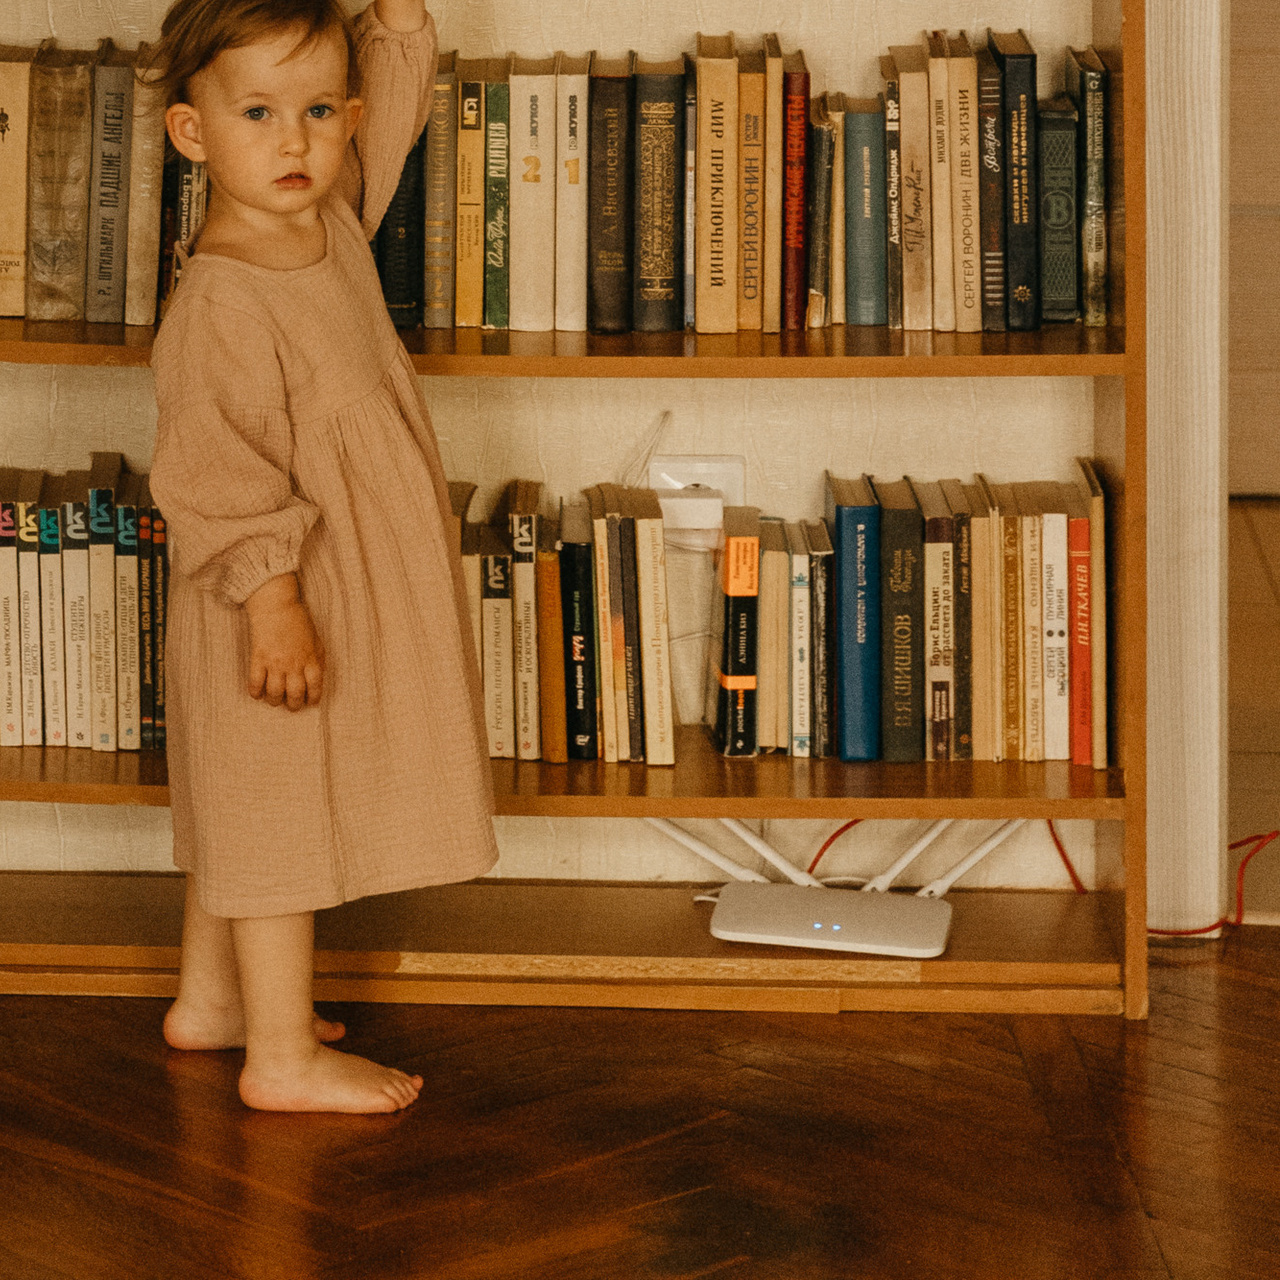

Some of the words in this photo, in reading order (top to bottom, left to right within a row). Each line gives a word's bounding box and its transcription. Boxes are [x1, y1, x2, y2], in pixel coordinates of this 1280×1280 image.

[710, 99, 724, 139] МИР
[100, 151, 121, 208] ПАДШИЕ
[745, 157, 759, 234] ВОРОНИН
[888, 149, 899, 197] Олдридж
[710, 149, 726, 287] ПРИКЛЮЧЕНИЙ
[889, 200, 901, 244] Джеймс
[99, 218, 114, 280] ШТИЛЬМАРК
[744, 241, 757, 300] СЕРГЕЙ
[931, 635, 941, 667] Борис
